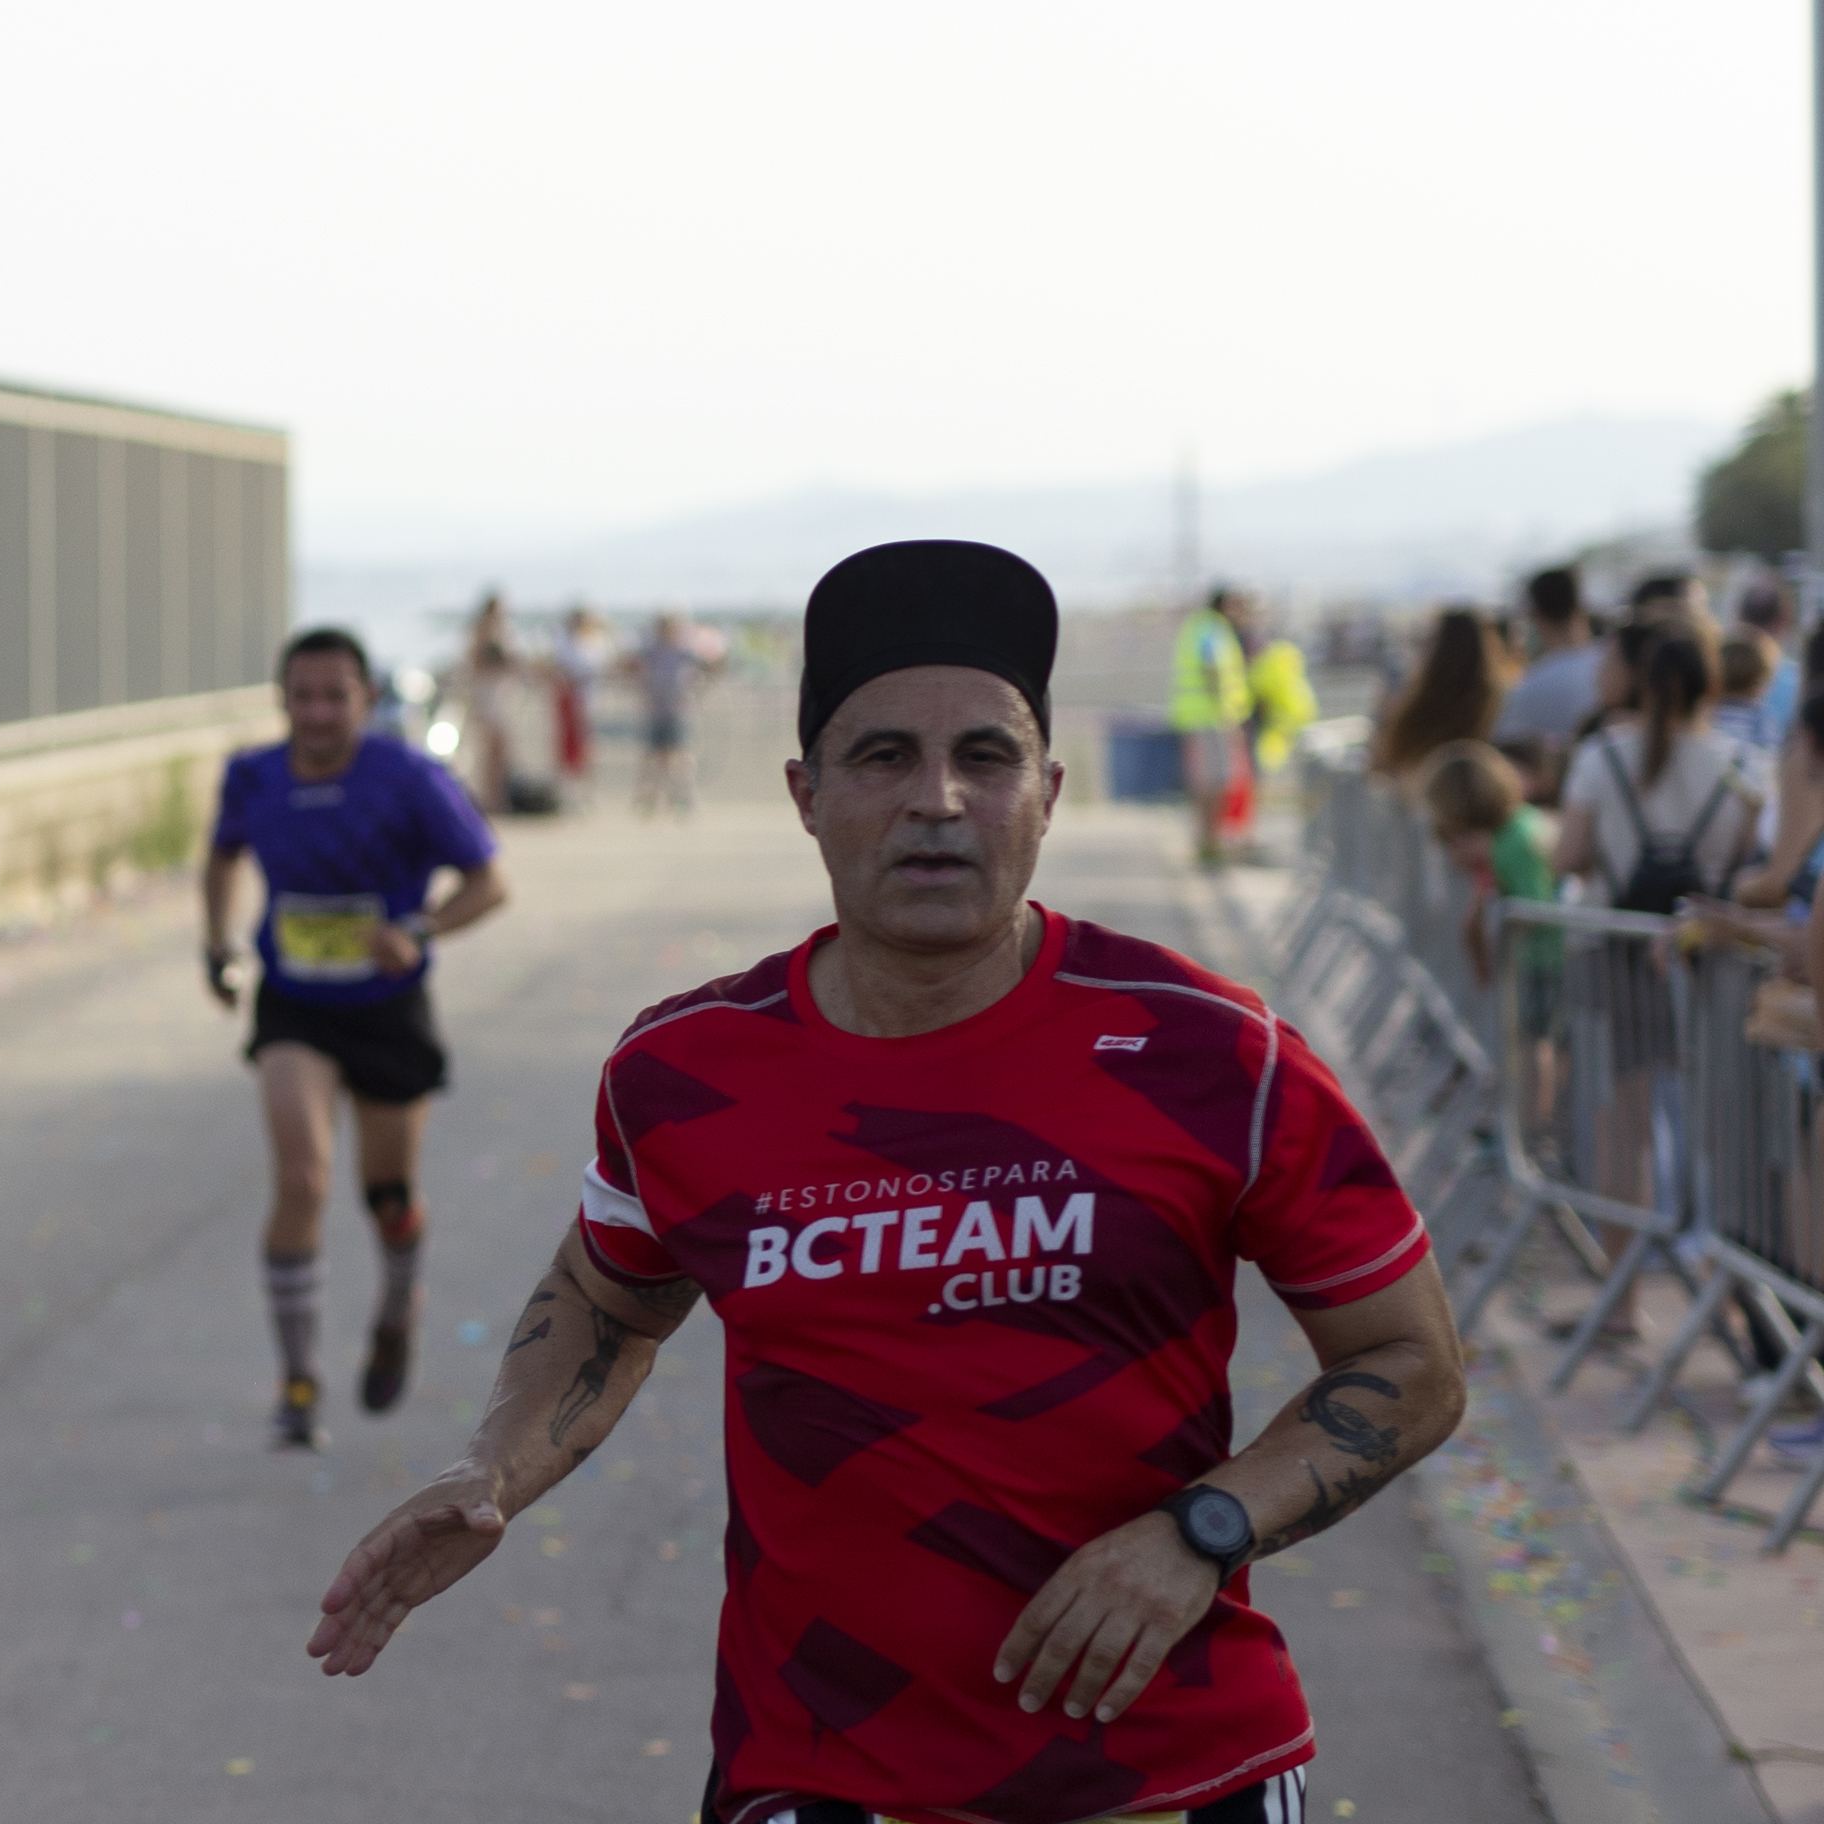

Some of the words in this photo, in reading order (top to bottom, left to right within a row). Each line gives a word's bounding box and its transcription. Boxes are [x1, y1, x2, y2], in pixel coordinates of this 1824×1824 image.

[753, 1158, 1080, 1215] #ESTONOSEPARA
[742, 1191, 1097, 1290] BCTEAM
[927, 1264, 1083, 1316] .CLUB
